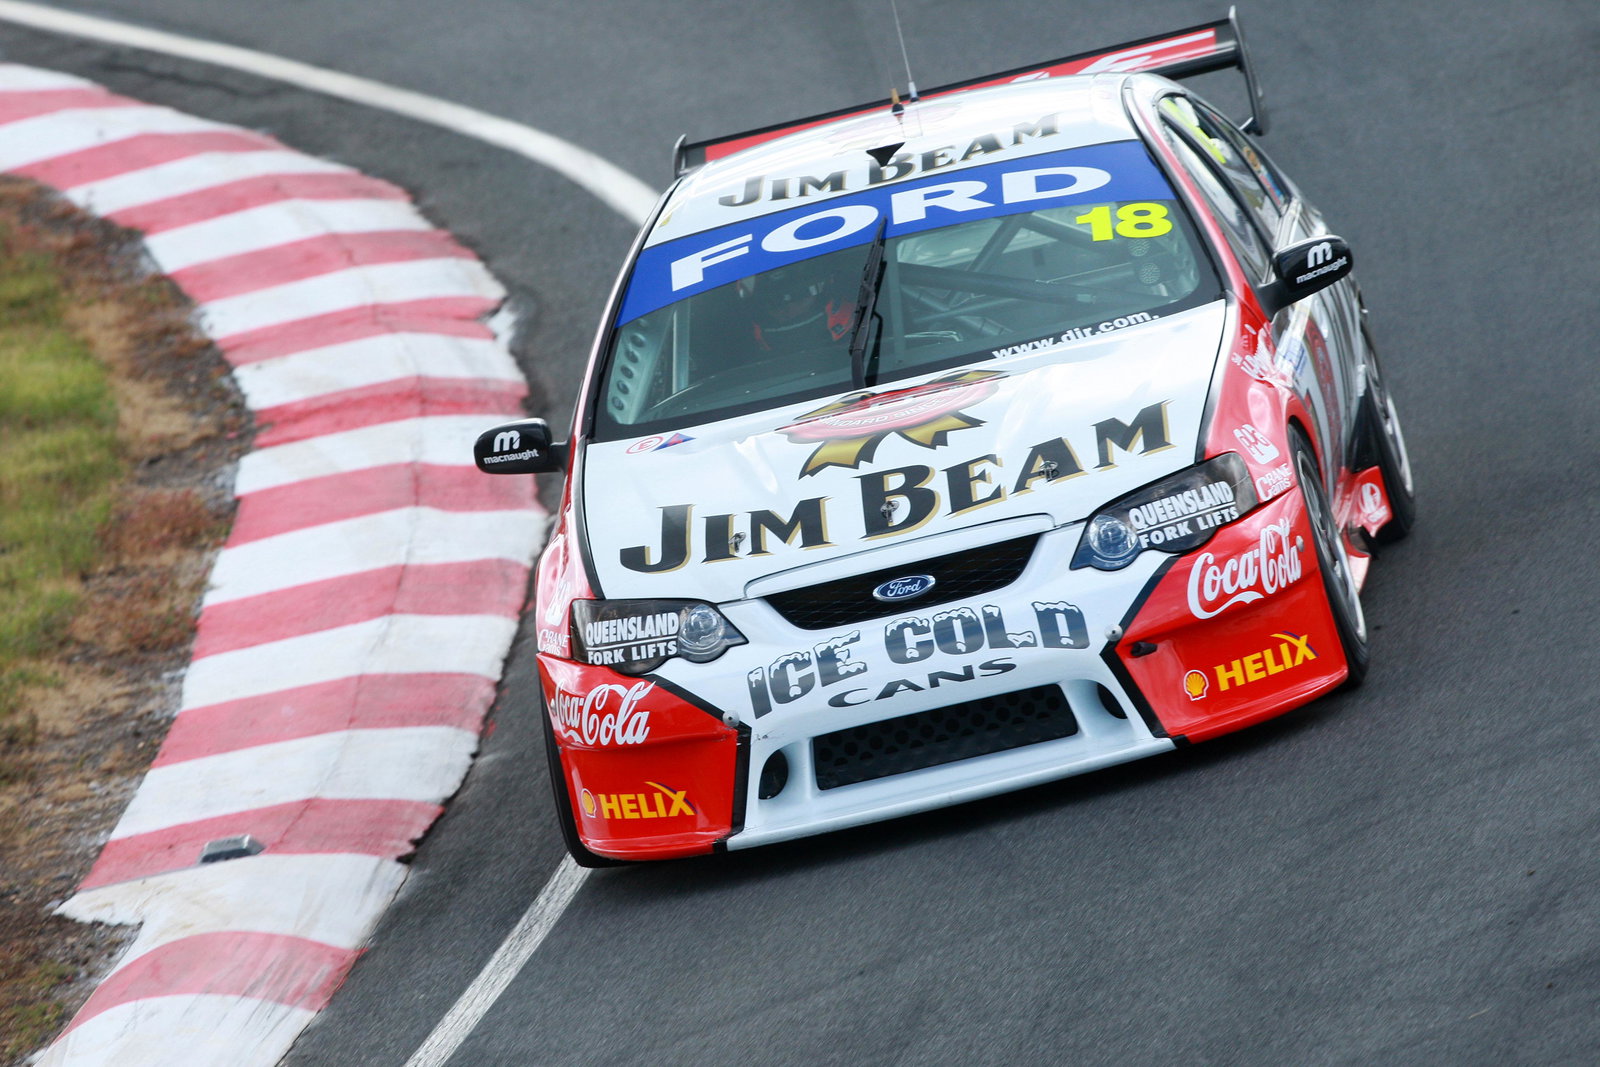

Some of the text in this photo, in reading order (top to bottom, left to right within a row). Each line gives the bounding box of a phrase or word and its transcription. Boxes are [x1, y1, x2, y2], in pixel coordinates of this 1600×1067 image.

[718, 113, 1061, 207] JIM BEAM
[671, 166, 1112, 292] FORD
[1076, 203, 1172, 241] 18
[1296, 256, 1348, 284] macnaught
[483, 449, 539, 464] macnaught
[620, 401, 1178, 574] JIM BEAM
[1129, 481, 1234, 531] QUEENSLAND
[1138, 506, 1240, 549] FORK LIFTS
[887, 579, 921, 597] Ford
[1187, 516, 1302, 620] Coca-Cola
[586, 612, 680, 645] QUEENSLAND
[588, 641, 678, 665] FORK LIFTS
[747, 601, 1090, 719] ICE COLD
[828, 657, 1017, 707] CANS
[1213, 632, 1318, 691] HELIX
[555, 680, 656, 745] Coca-Cola
[598, 783, 698, 819] HELIX
